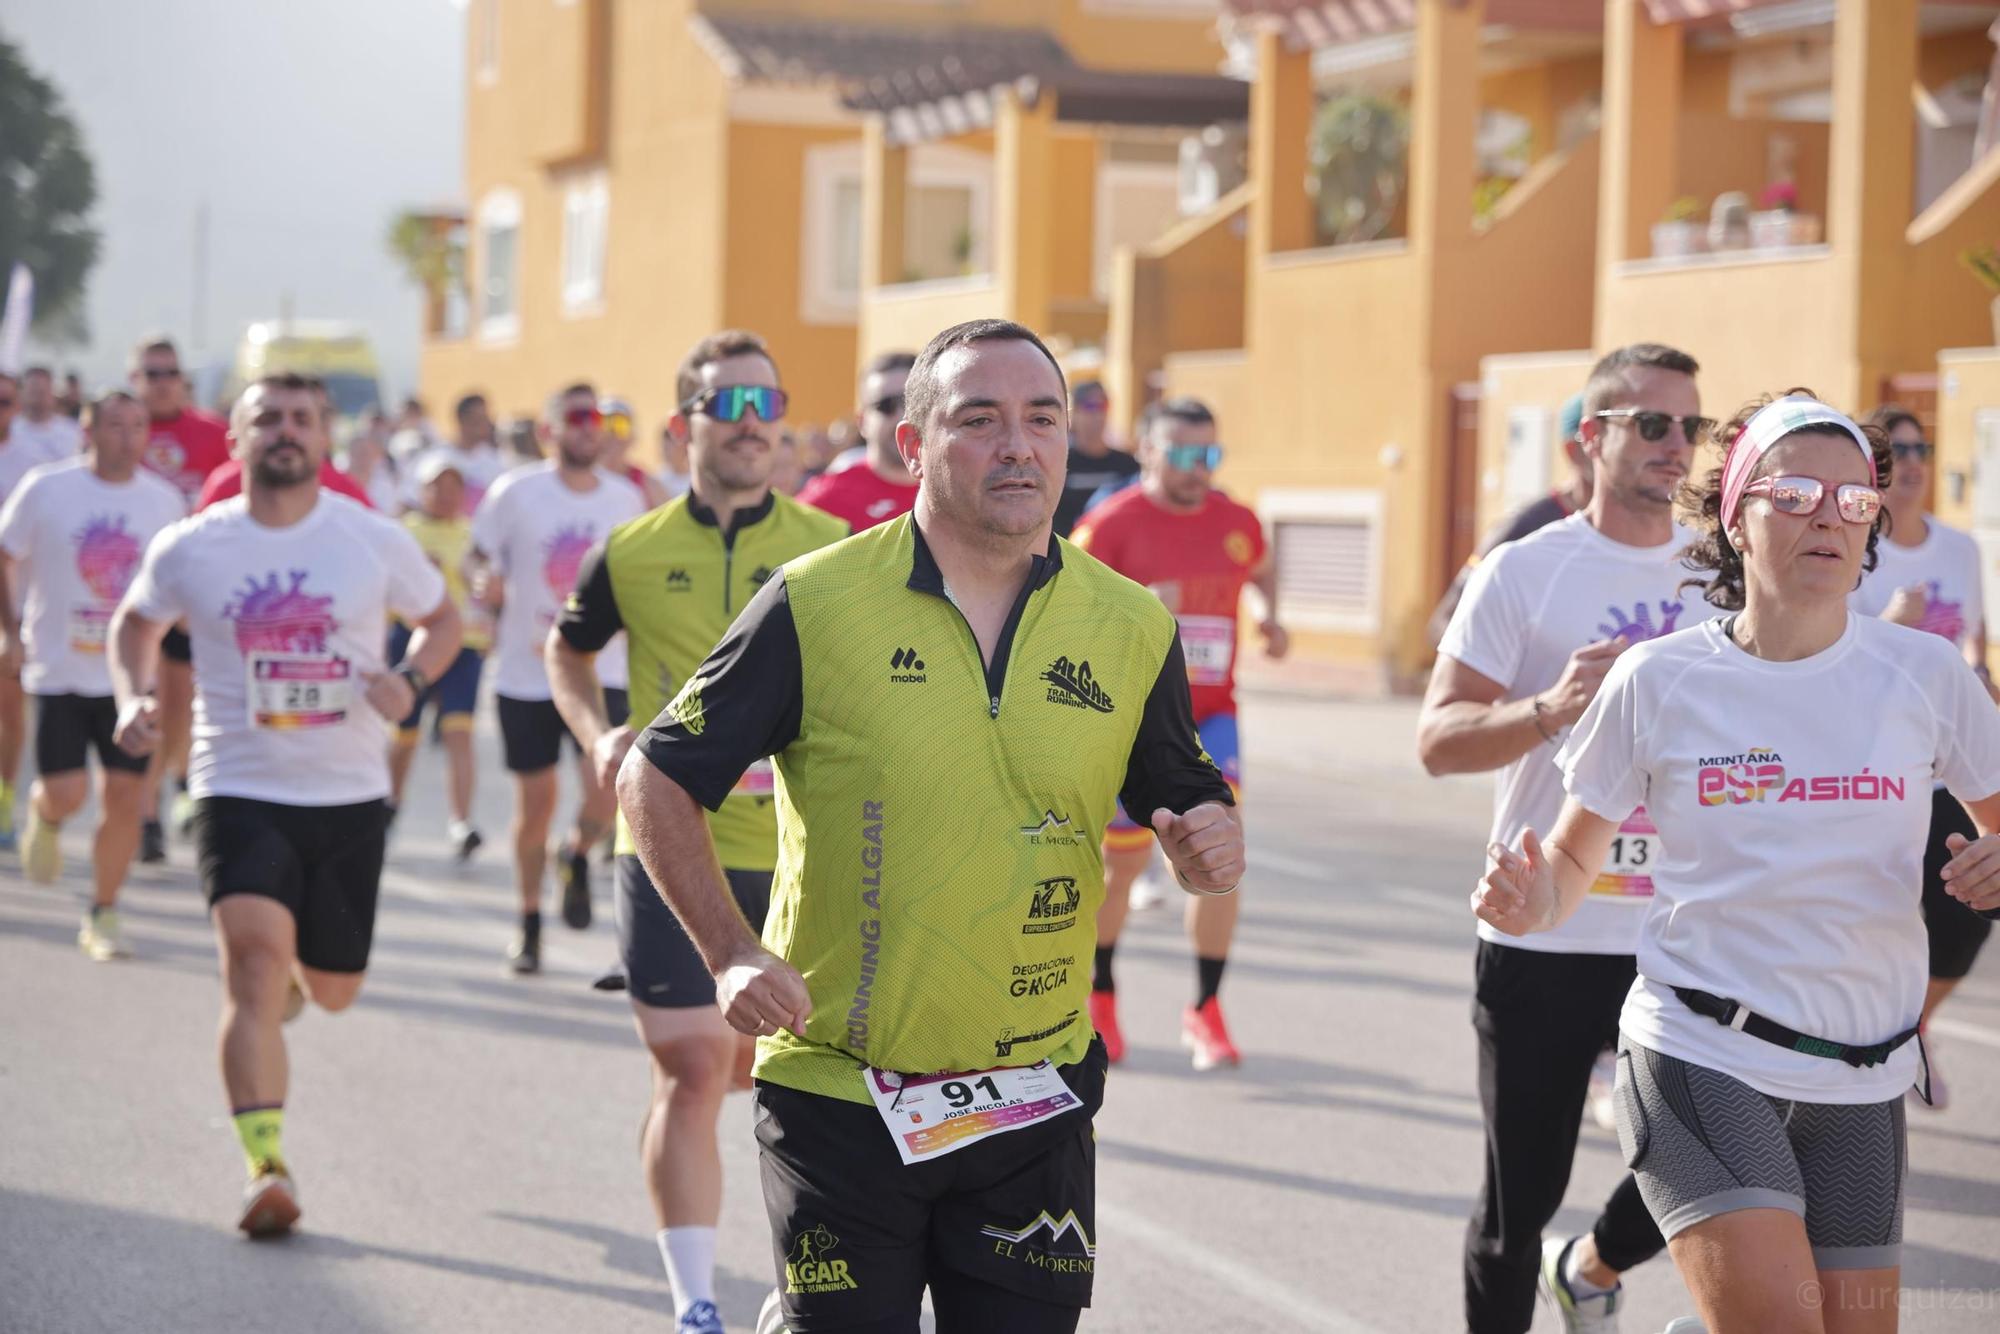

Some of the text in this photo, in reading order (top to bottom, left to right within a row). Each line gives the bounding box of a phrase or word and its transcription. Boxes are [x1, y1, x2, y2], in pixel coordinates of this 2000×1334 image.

[891, 674, 926, 684] mobel
[1053, 655, 1115, 709] ALGAR
[1046, 695, 1087, 709] RUNNING
[1047, 688, 1074, 700] TRAIL
[1699, 747, 1782, 766] MONTAÑA
[1611, 837, 1649, 865] 13
[847, 800, 884, 1049] RUNNING ALGAR
[941, 1075, 1003, 1108] 91
[943, 1097, 1024, 1121] JOSE NICOLAS
[994, 1240, 1017, 1259] EL
[786, 1260, 858, 1288] ALGAR
